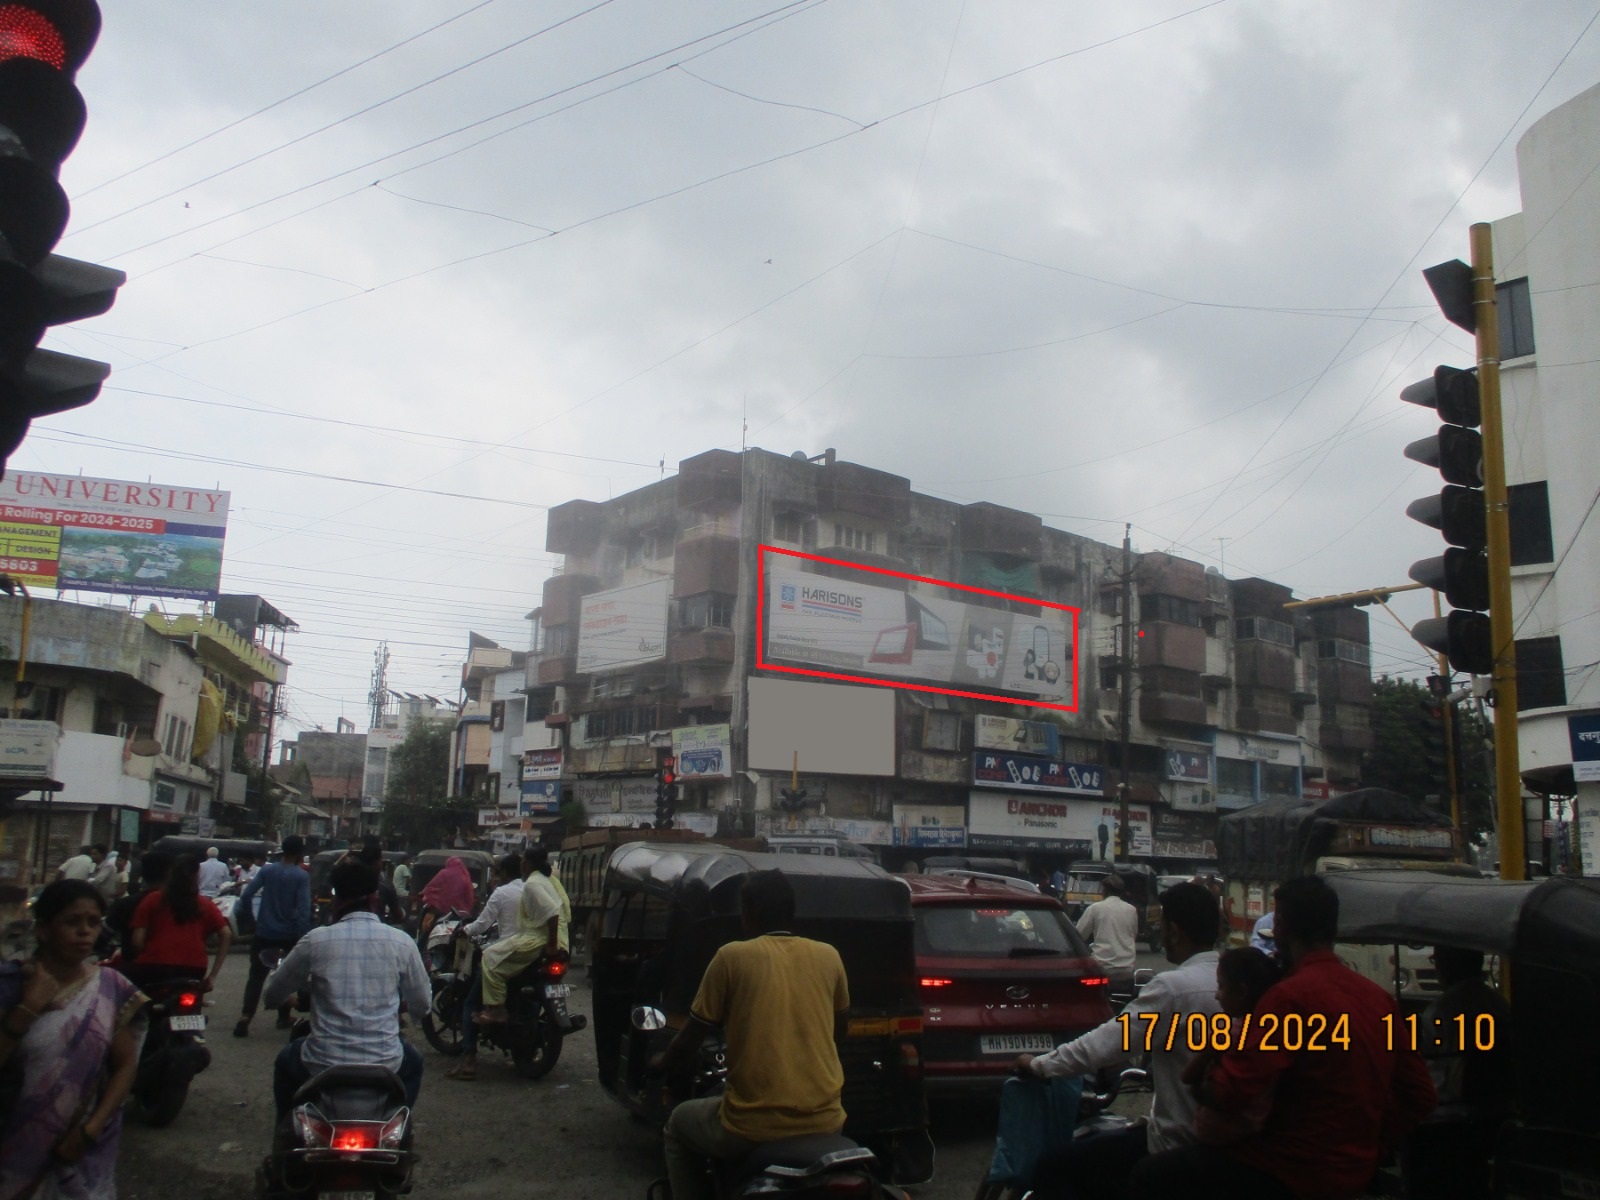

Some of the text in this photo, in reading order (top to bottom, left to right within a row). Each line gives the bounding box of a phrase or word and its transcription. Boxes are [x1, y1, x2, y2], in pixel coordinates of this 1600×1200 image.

[15, 474, 223, 513] UNIVERSITY
[6, 507, 53, 523] Rolling
[56, 511, 78, 522] For
[80, 513, 153, 529] 2024-2025
[802, 586, 863, 608] HARISONS
[1019, 802, 1067, 817] ANCHOR
[1024, 818, 1058, 829] Panasonic
[989, 1036, 1052, 1050] MH19DV9398
